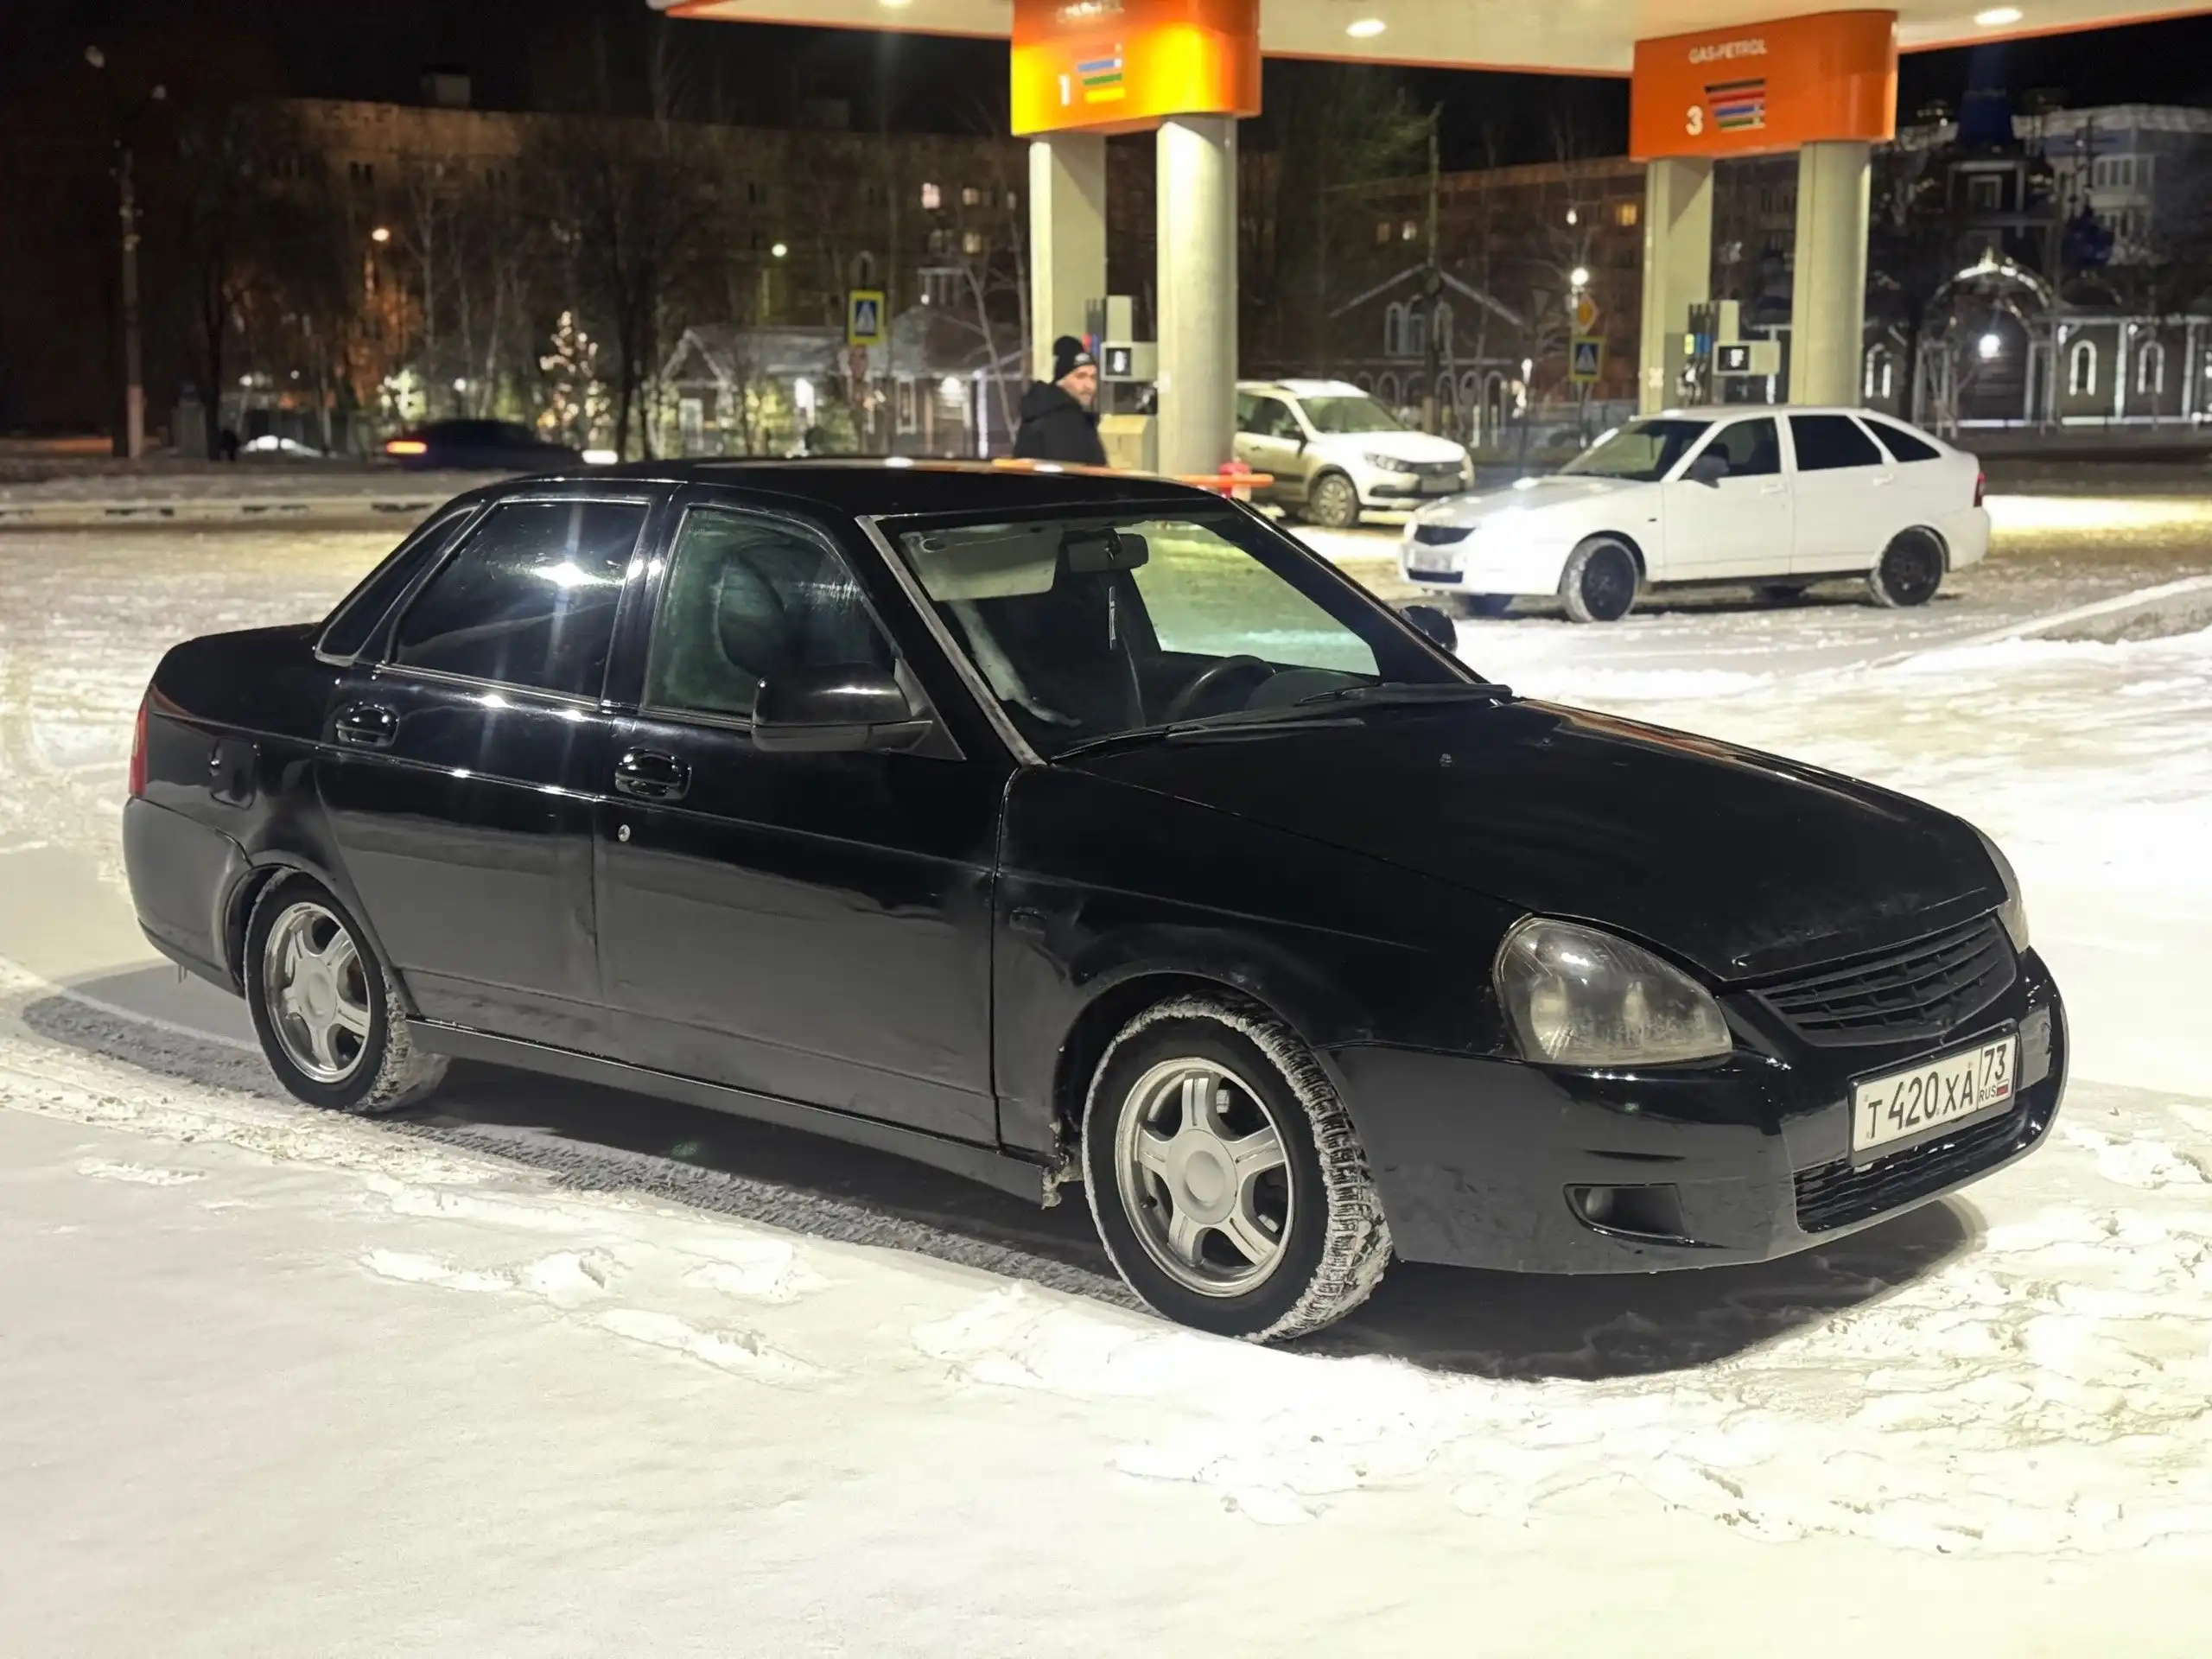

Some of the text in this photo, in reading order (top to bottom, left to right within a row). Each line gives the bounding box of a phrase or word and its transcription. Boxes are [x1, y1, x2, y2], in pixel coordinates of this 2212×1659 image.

[1059, 75, 1070, 105] 1
[1686, 105, 1703, 136] 3
[1984, 1044, 2007, 1086] 73
[1979, 1086, 1997, 1103] RUS
